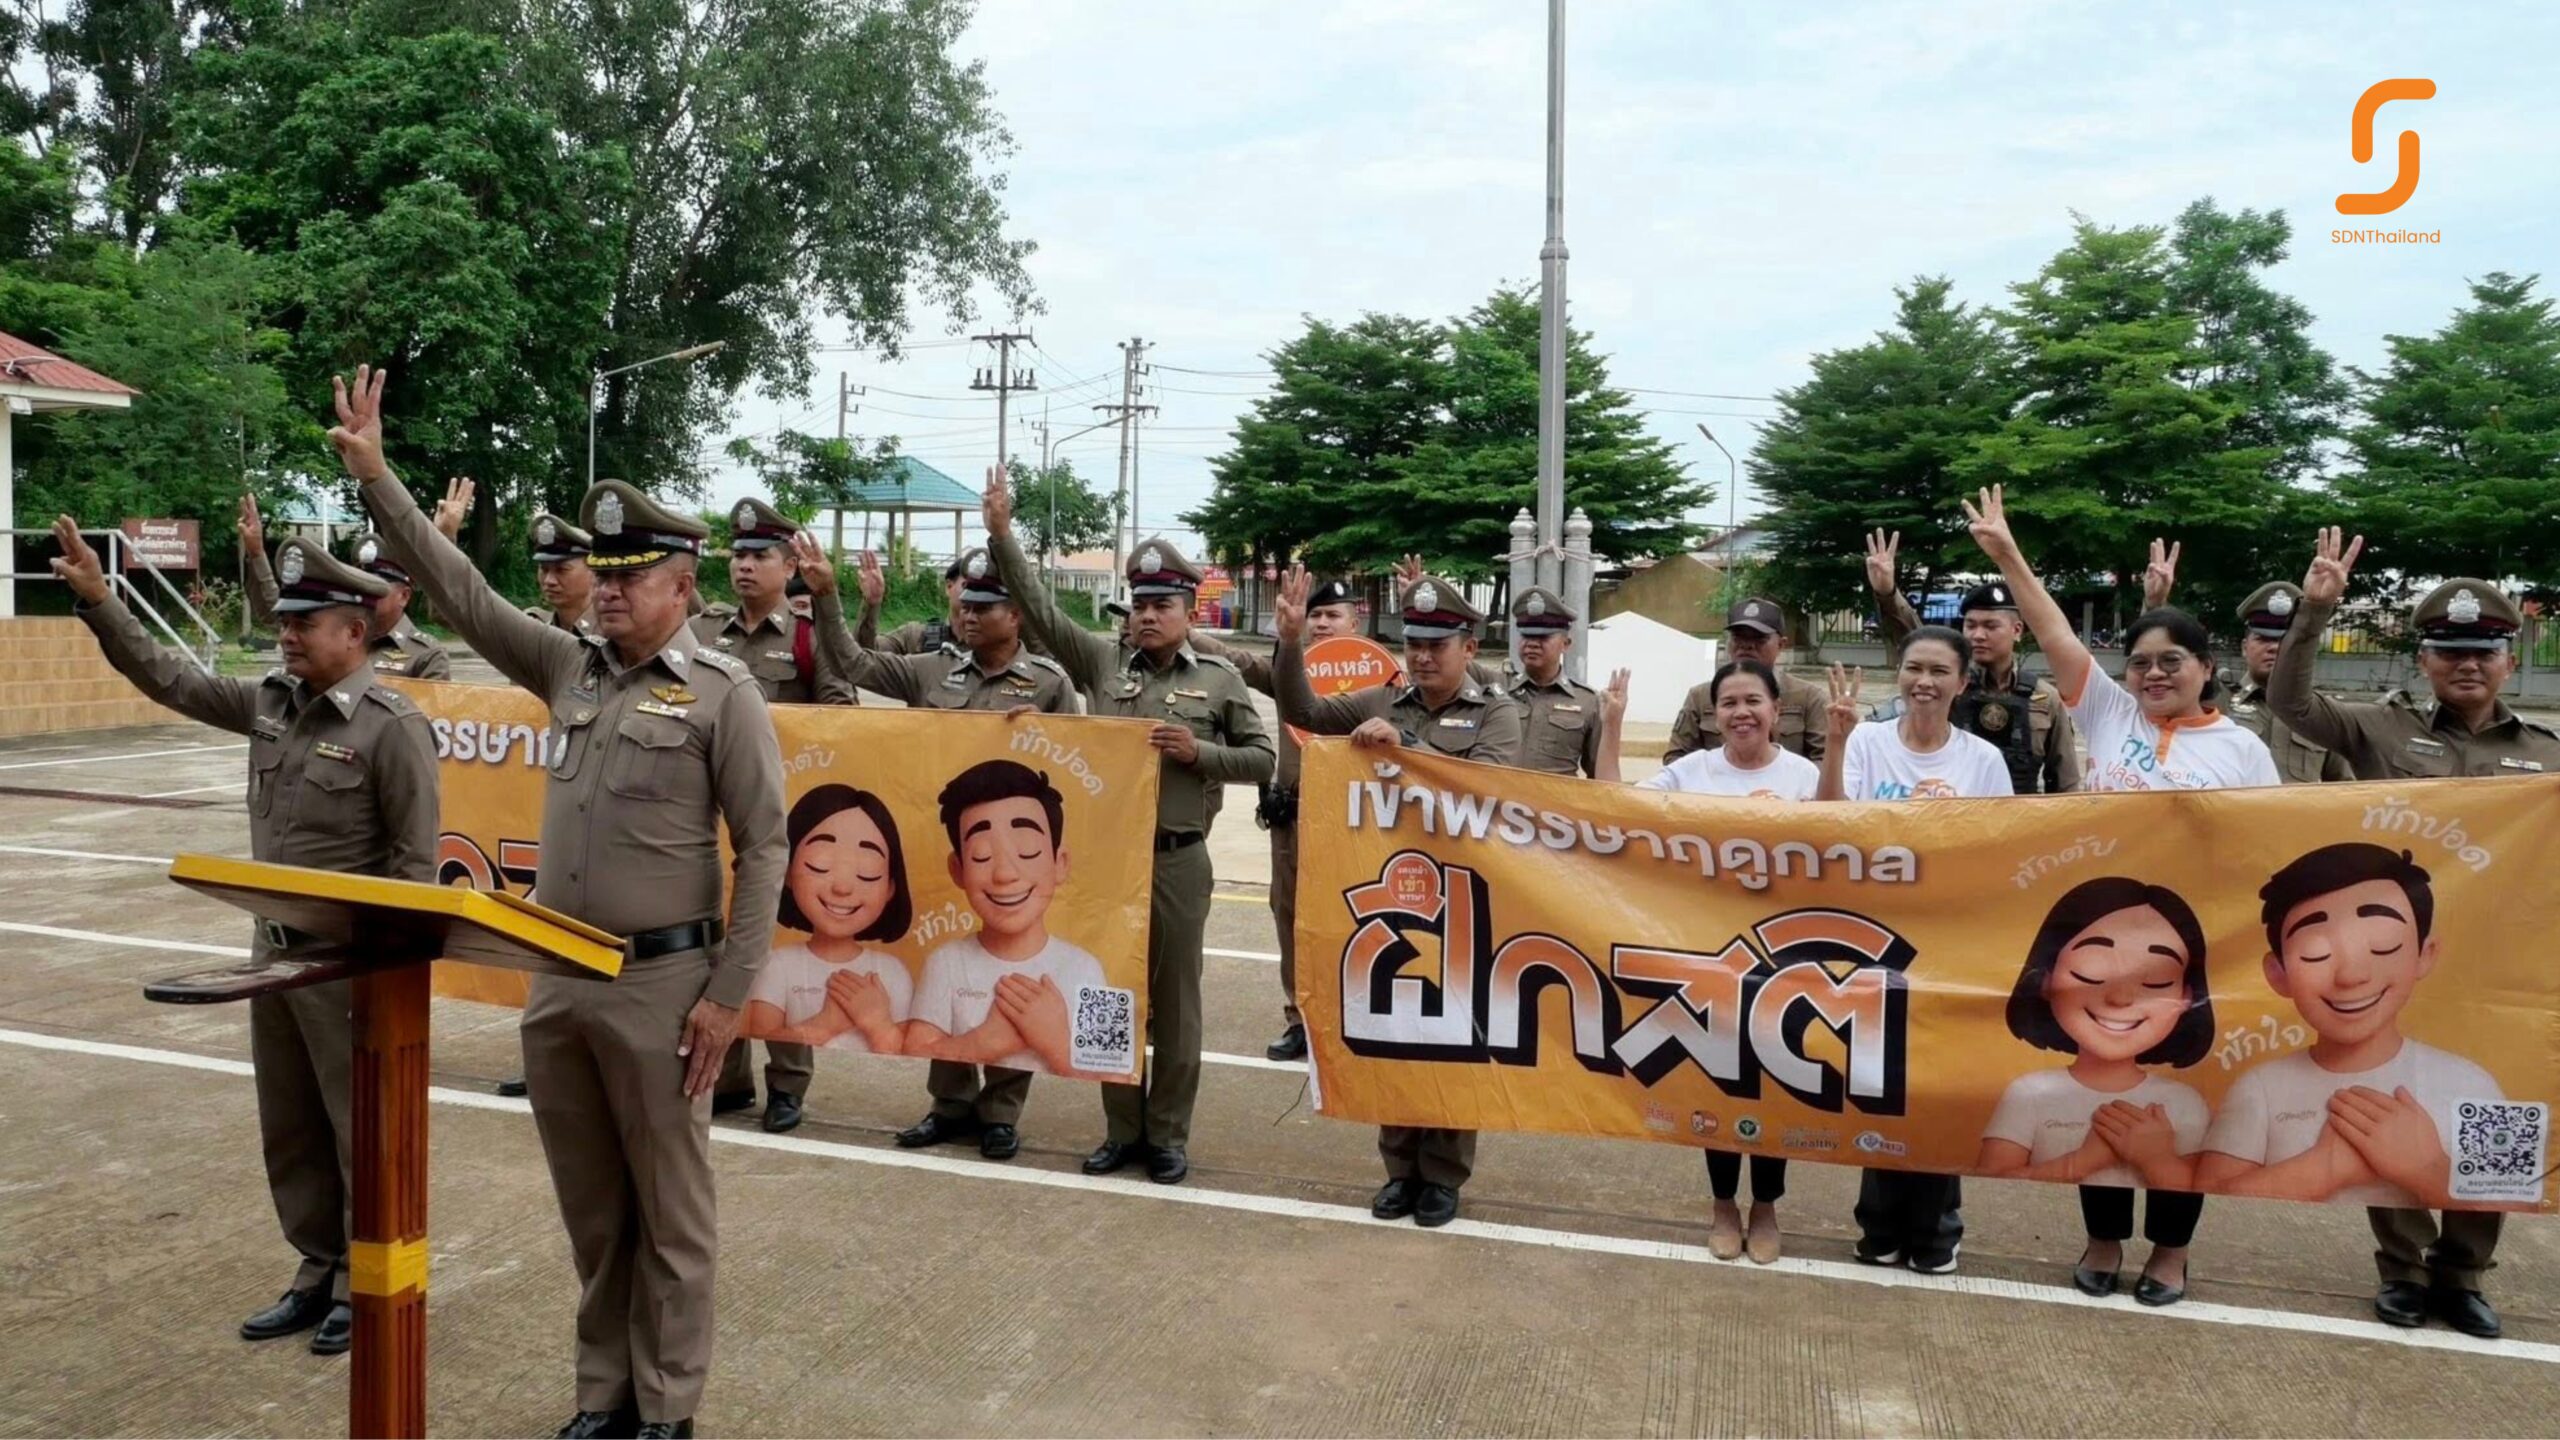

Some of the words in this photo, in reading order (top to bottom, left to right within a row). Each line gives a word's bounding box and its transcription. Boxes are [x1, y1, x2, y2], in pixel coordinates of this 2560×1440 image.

[1306, 652, 1383, 677] งดเหล้า
[1010, 724, 1104, 797] พักปอด
[2121, 735, 2156, 772] สุข
[1347, 761, 1916, 889] เข้าพรรษาฤดูกาล
[2362, 796, 2491, 872] พักปอด
[2010, 835, 2118, 889] พักตับ
[912, 902, 973, 946] พักใจ
[1340, 850, 1918, 1116] ฝึกสติ
[2214, 1015, 2305, 1070] พักใจ
